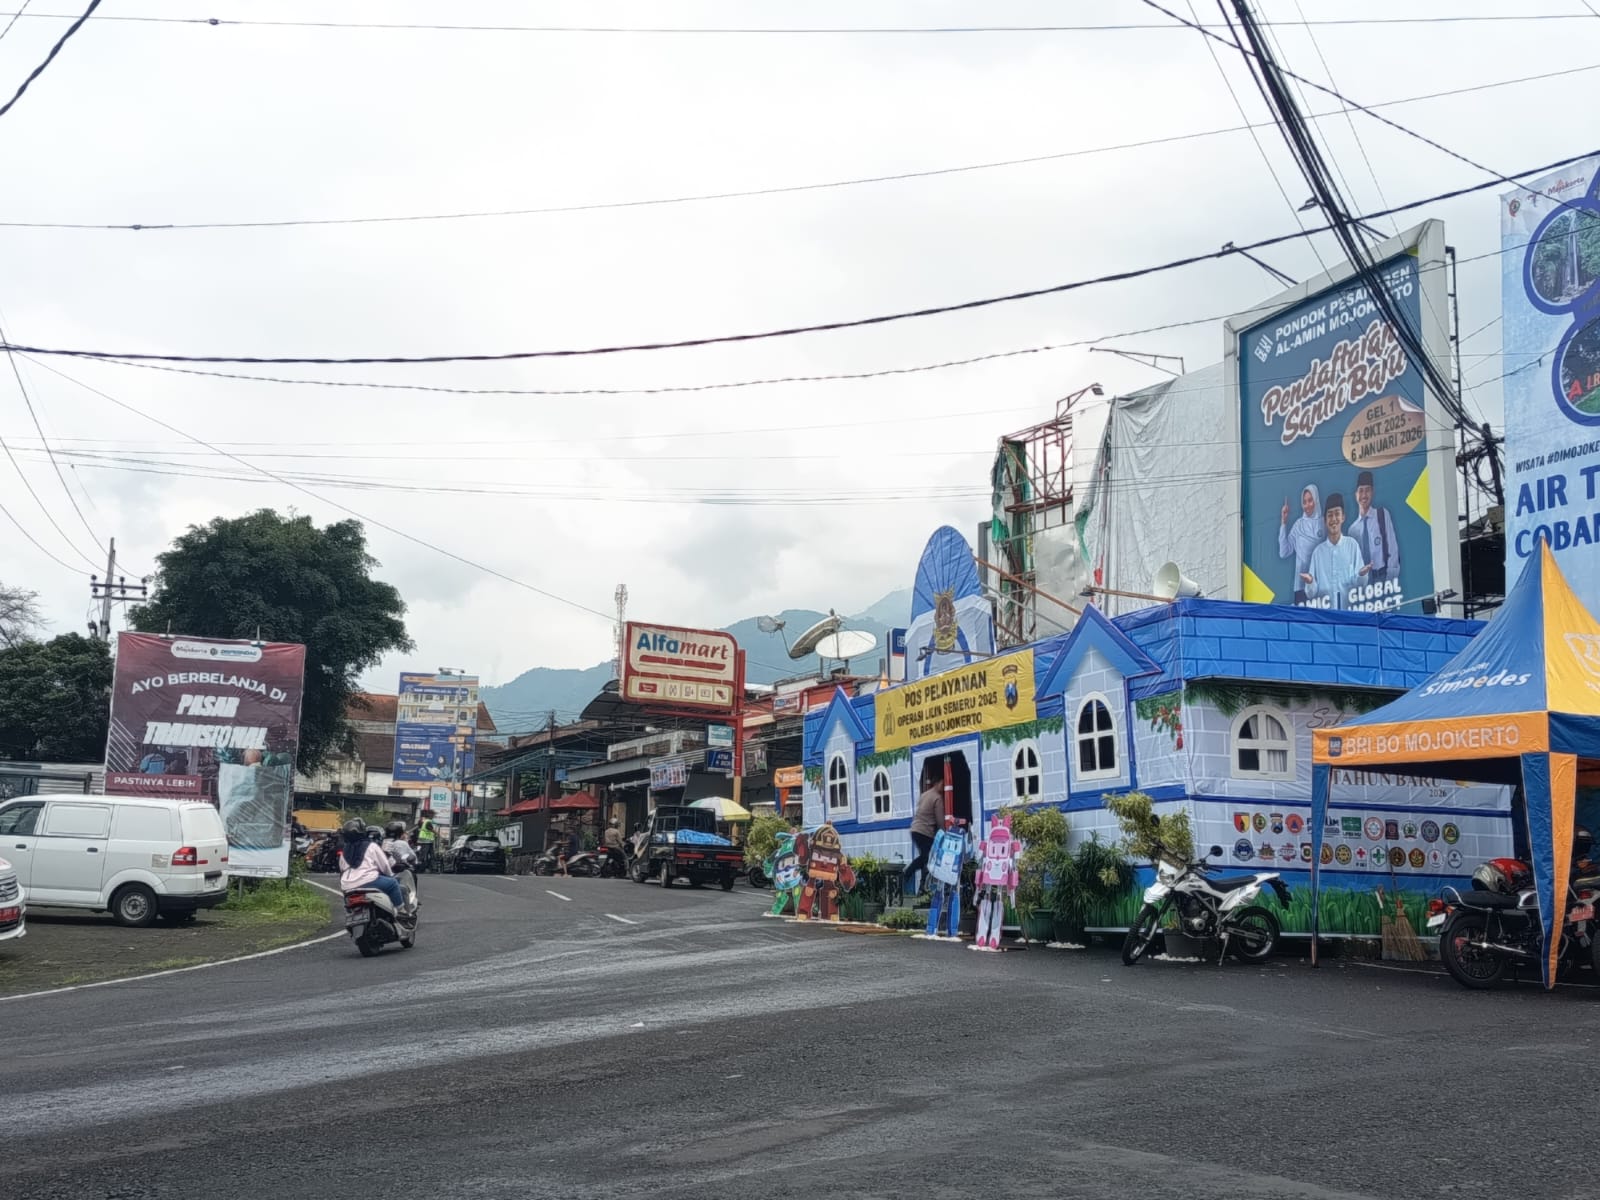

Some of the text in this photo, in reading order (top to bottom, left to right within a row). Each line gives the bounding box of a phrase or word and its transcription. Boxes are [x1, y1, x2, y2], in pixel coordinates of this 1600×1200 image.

[1275, 305, 1327, 341] PONDOK
[1275, 322, 1326, 357] AL-AMIN
[1261, 319, 1400, 426] Pendaftaran
[1281, 375, 1348, 446] Santri
[1348, 343, 1408, 404] Baru
[1367, 400, 1394, 421] GEL 1
[1351, 430, 1361, 445] 23
[1364, 421, 1382, 440] OKT
[1384, 413, 1406, 432] 2025
[1351, 425, 1423, 462] 6 JANUARI 2026
[1516, 455, 1545, 473] WISATA
[1515, 473, 1569, 517] AIR
[1348, 577, 1402, 604] GLOBAL
[636, 631, 729, 660] Alfamart
[131, 672, 287, 703] AYO BERBELANJA DI
[905, 690, 922, 709] POS
[924, 670, 987, 703] PELAYANAN
[175, 693, 241, 718] PASAR
[897, 691, 998, 727] OPERASI LILIN SEMERU 2025
[909, 711, 983, 740] POLRES MOJOKERTO
[1346, 736, 1372, 755] BRI
[1376, 735, 1400, 753] BO
[1405, 724, 1520, 752] MOJOKERTO
[113, 776, 196, 788] PASTINYA LEBIH
[1332, 769, 1390, 786] TAHUN
[1429, 788, 1447, 798] 2026
